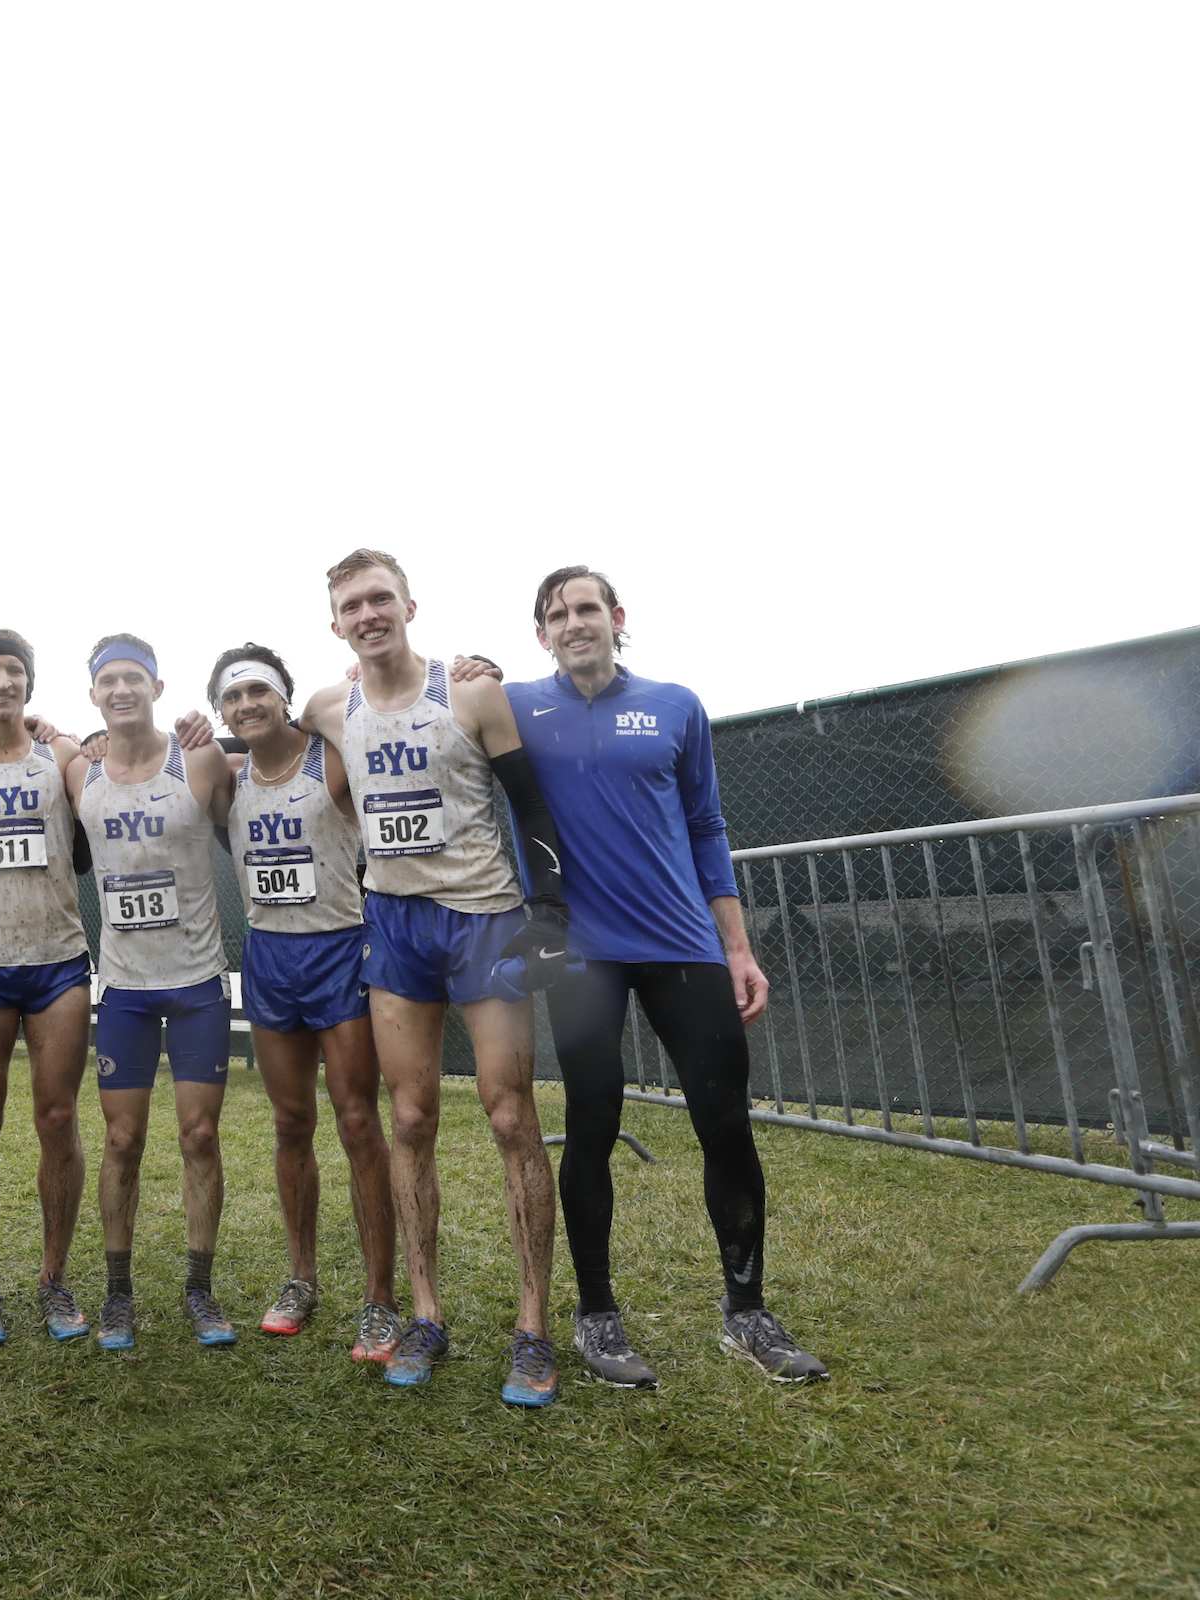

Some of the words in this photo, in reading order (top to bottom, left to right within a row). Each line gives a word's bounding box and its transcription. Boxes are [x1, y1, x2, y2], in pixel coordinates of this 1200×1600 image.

[615, 711, 657, 729] BYU
[366, 741, 428, 776] BYU
[103, 811, 165, 842] BYU
[248, 813, 302, 845] BYU
[379, 814, 430, 844] 502
[256, 868, 300, 894] 504
[119, 892, 164, 919] 513
